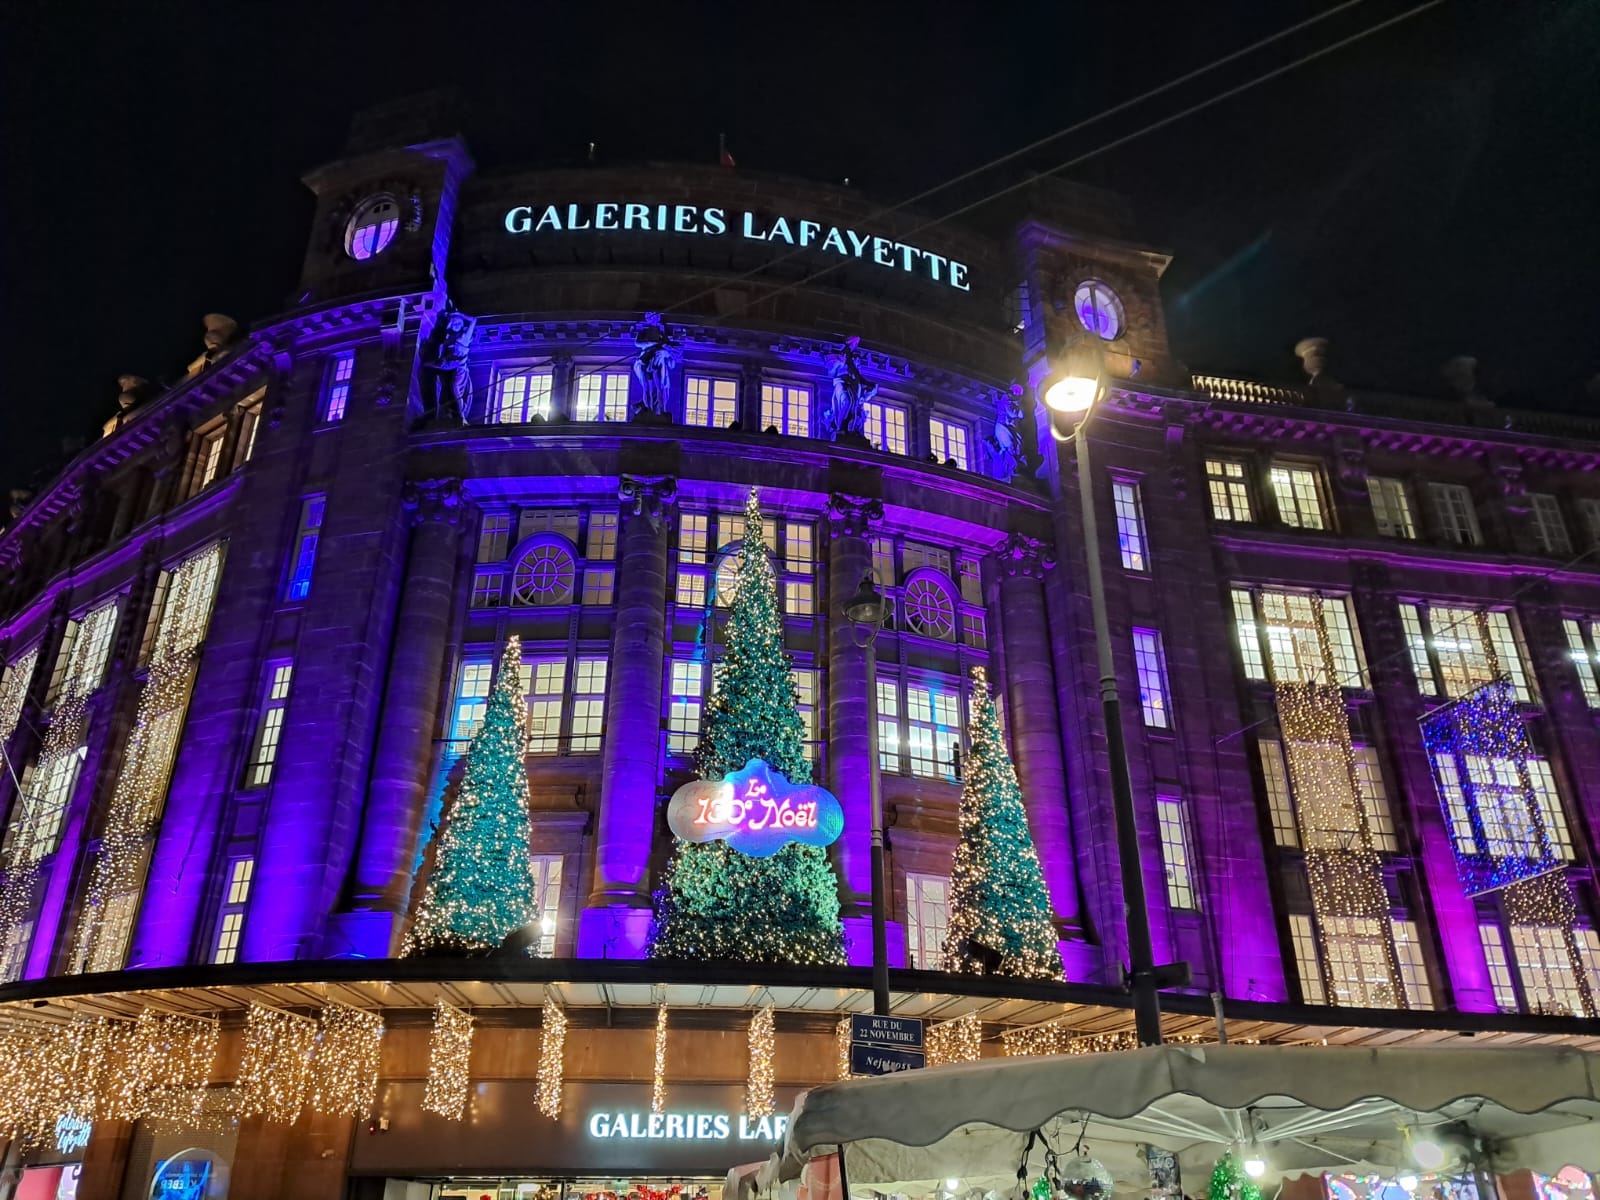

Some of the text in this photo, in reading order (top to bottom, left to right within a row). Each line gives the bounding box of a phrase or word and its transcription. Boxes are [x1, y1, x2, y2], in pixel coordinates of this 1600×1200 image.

[504, 203, 971, 291] GALERIES LAFAYETTE
[748, 798, 818, 830] Noël
[860, 1028, 915, 1042] 22 NOVEMBRE
[872, 1019, 902, 1030] RUE DU
[589, 1113, 730, 1139] GALERIES
